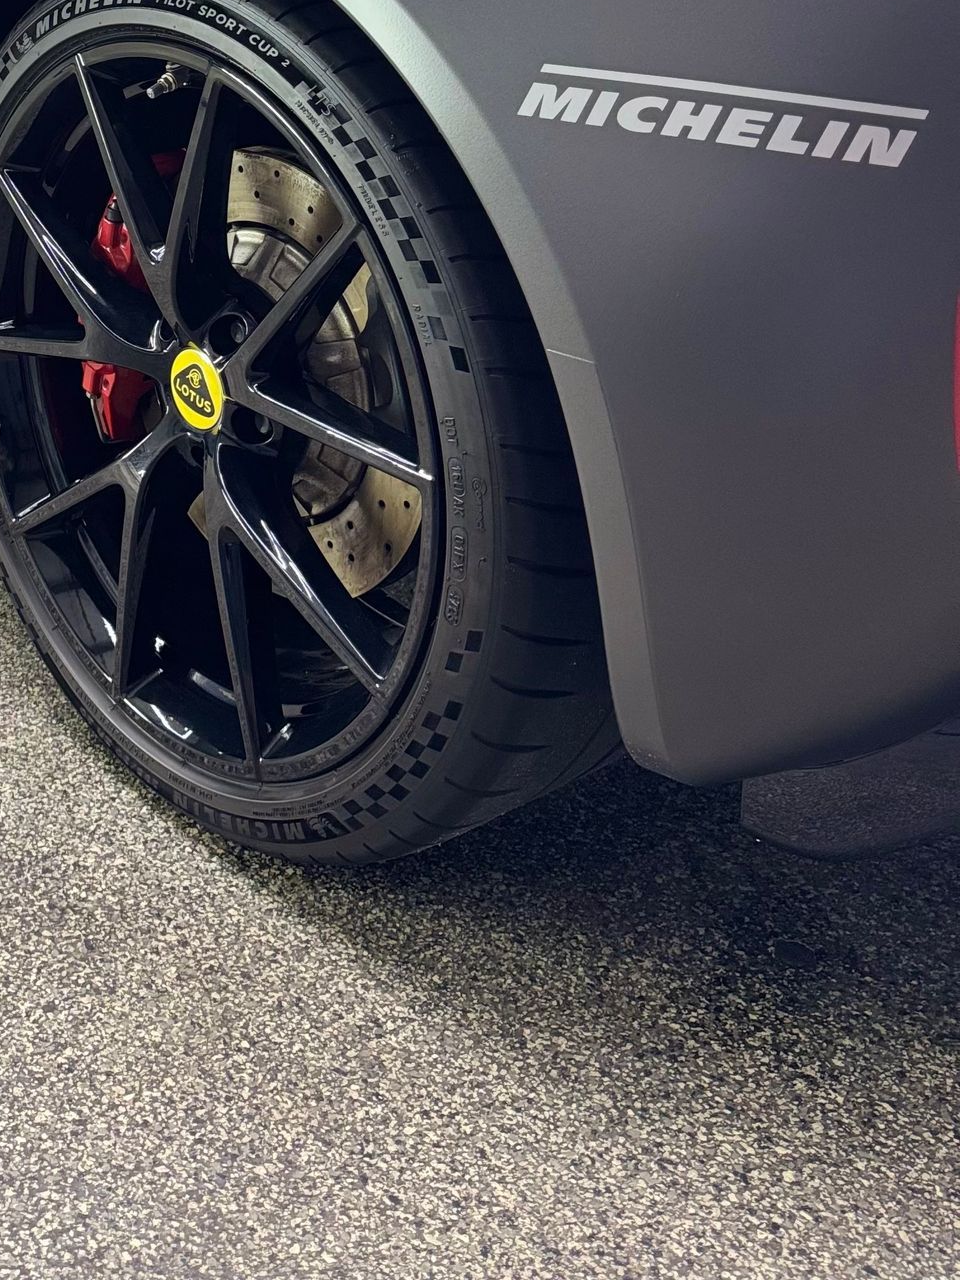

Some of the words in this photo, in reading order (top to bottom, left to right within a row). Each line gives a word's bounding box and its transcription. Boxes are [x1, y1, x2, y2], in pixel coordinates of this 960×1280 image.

[198, 5, 247, 35] SPORT
[248, 34, 279, 58] CUP
[281, 59, 291, 68] 2
[517, 82, 917, 167] MICHELIN
[176, 378, 211, 413] LOTUS
